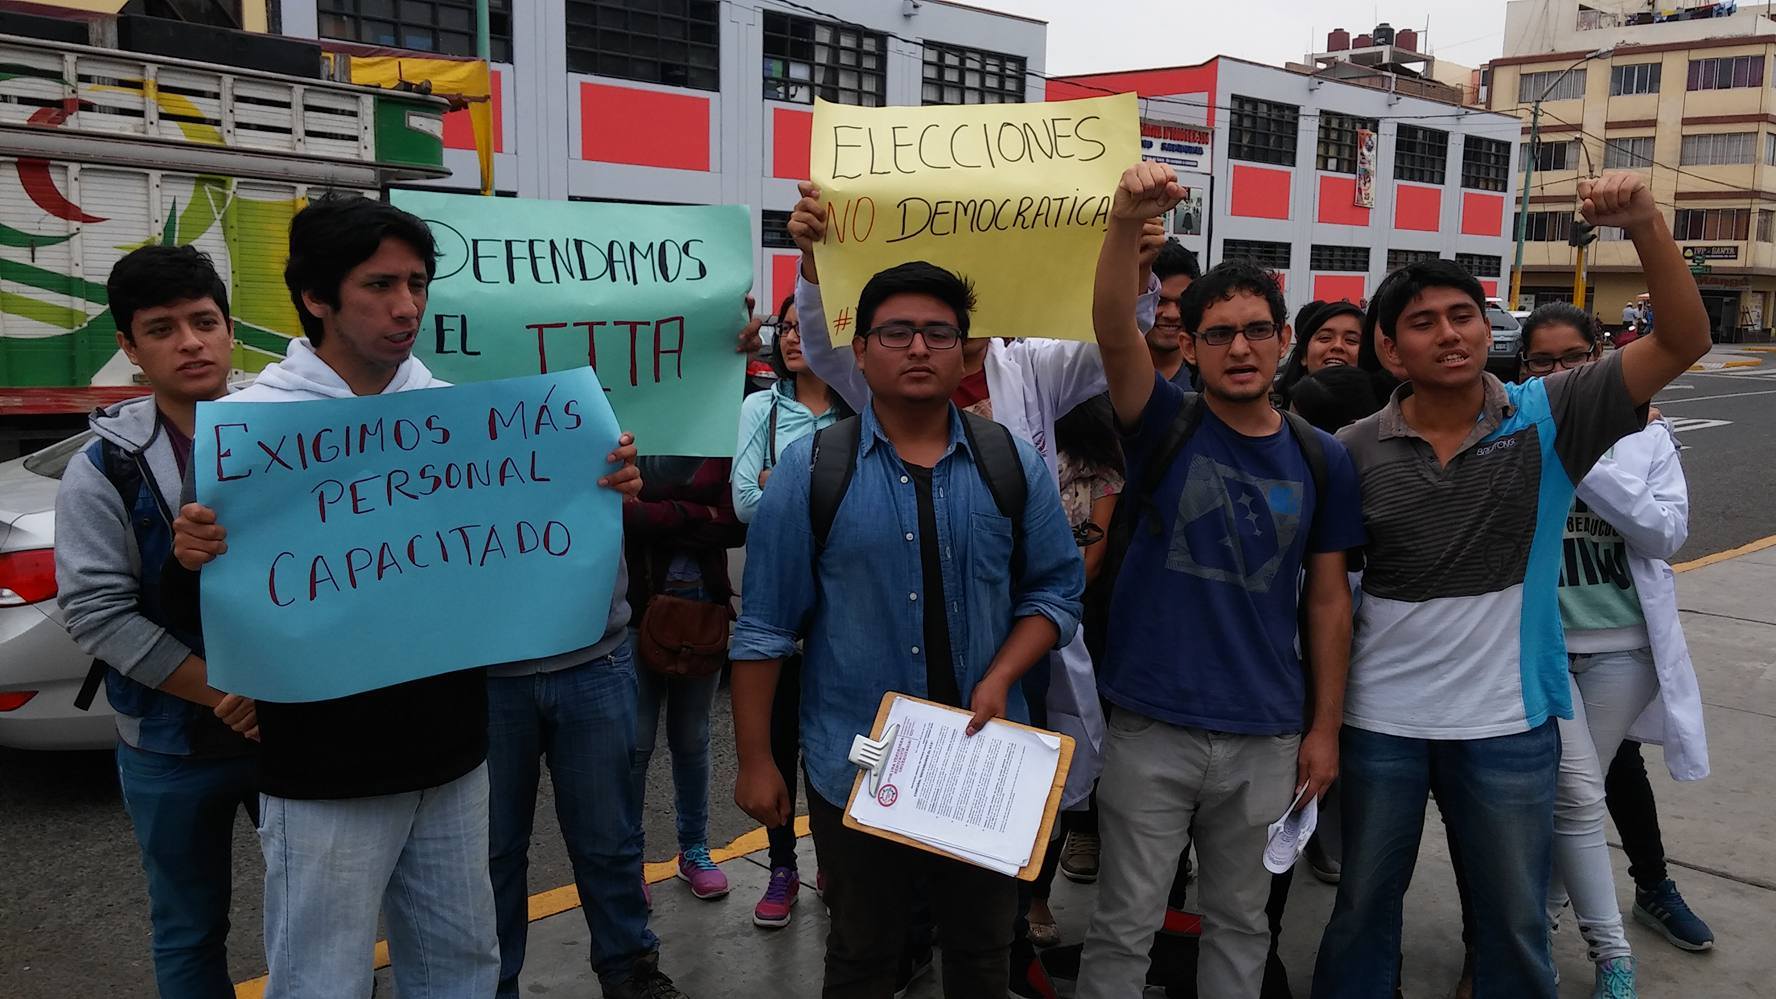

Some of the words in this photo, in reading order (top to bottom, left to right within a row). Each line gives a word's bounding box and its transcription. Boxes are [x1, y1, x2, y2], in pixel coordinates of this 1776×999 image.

[832, 115, 1107, 180] ELECCIONES
[823, 195, 876, 246] NO
[885, 187, 1113, 244] DEMOCRATICA
[420, 218, 708, 286] DEFENDAMOS
[434, 313, 482, 357] EL
[213, 415, 452, 483] EXIGIMOS
[488, 384, 583, 442] MÁS
[311, 450, 552, 524] PERSONAL
[268, 520, 572, 608] CAPACITADO
